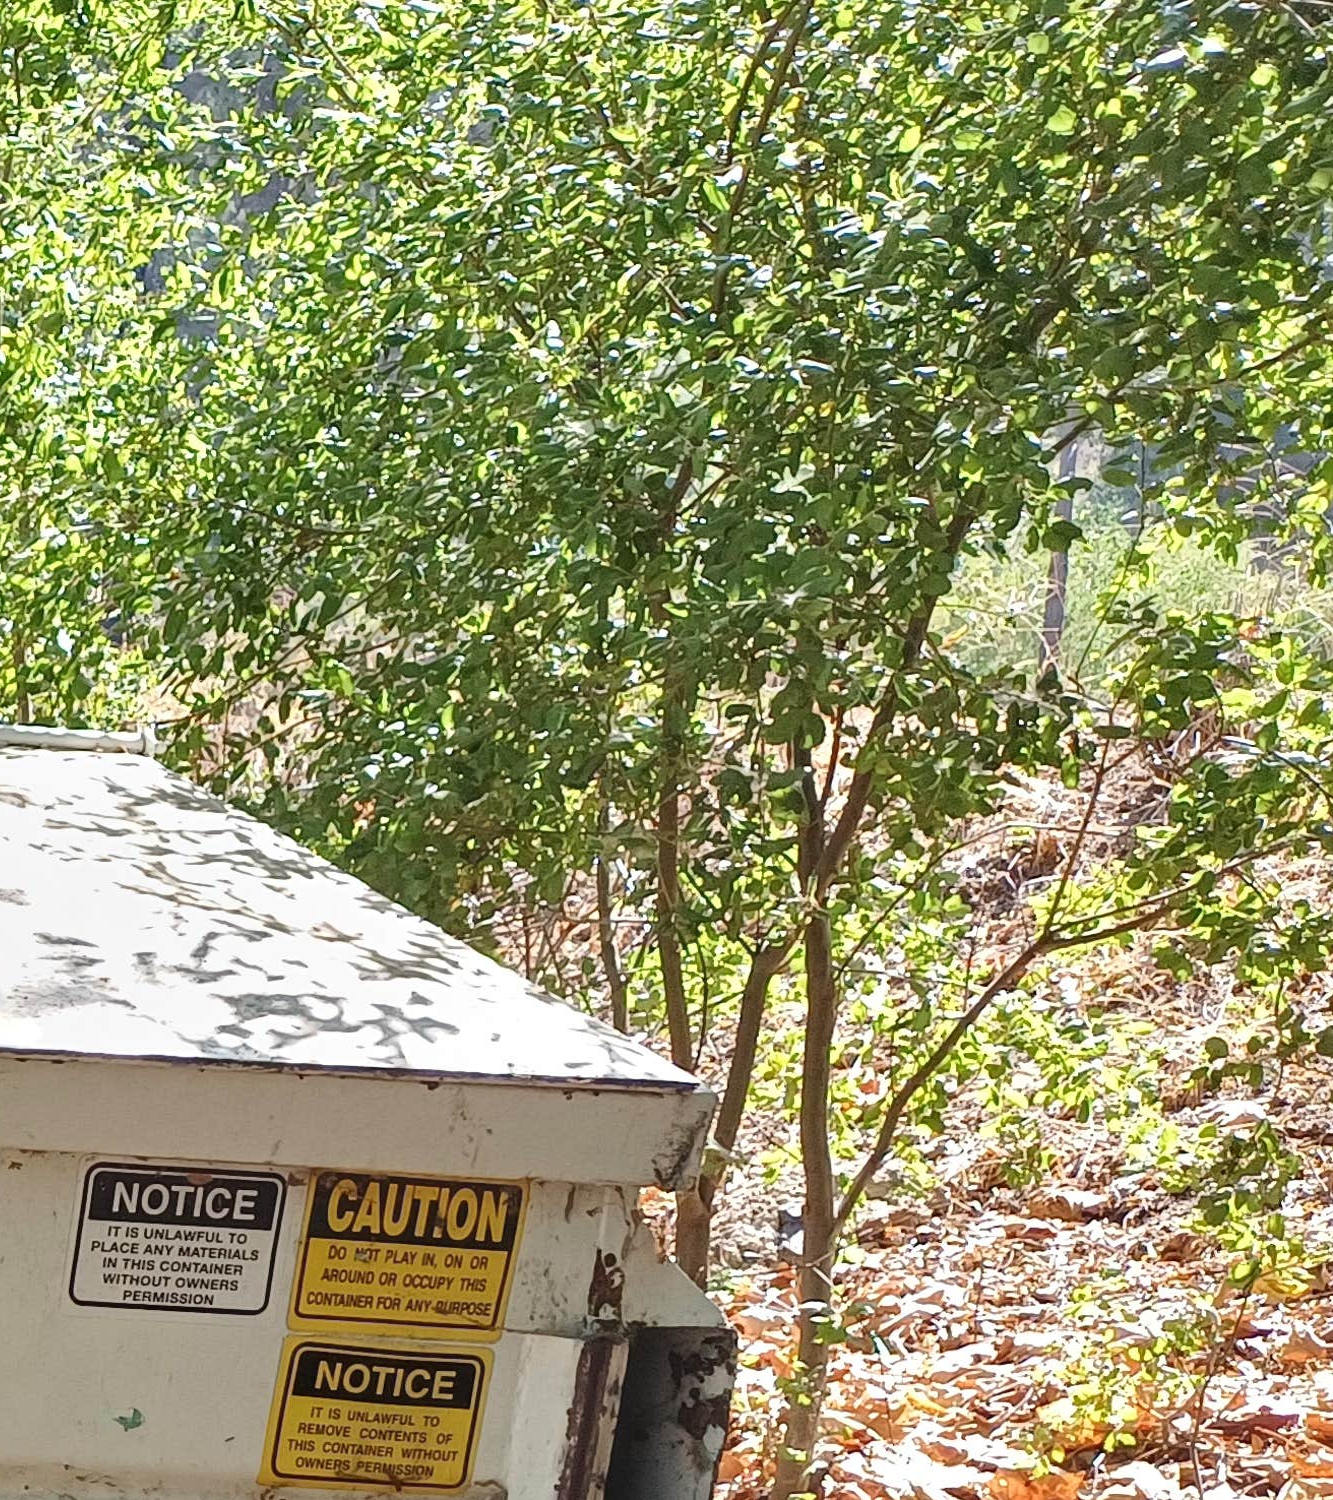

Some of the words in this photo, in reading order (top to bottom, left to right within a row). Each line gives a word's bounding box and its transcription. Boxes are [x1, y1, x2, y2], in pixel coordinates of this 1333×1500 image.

[112, 1181, 258, 1220] NOTICE
[327, 1178, 508, 1242] CAUTION
[107, 1226, 121, 1237] IT
[125, 1227, 139, 1238] IS
[144, 1228, 223, 1243] UNLAWFUL
[228, 1233, 247, 1243] TO
[91, 1241, 139, 1254] PLACE
[143, 1244, 173, 1255] ANY
[178, 1246, 259, 1260] MATERIALS
[328, 1245, 346, 1260] DO
[385, 1251, 417, 1264] PLAY
[422, 1253, 437, 1268] IN,
[445, 1254, 462, 1268] ON
[470, 1256, 488, 1269] OR
[103, 1257, 117, 1268] IN
[122, 1259, 155, 1270] THIS
[159, 1260, 243, 1275] CONTAINER
[103, 1274, 170, 1287] WITHOUT
[175, 1278, 238, 1291] OWNERS
[321, 1268, 374, 1284] AROUND
[379, 1272, 397, 1286] OR
[403, 1274, 454, 1290] OCCUPY
[460, 1278, 486, 1292] THIS
[123, 1291, 214, 1305] PERMISSION
[307, 1292, 373, 1308] CONTAINER
[376, 1295, 400, 1310] FOR
[405, 1299, 431, 1312] ANY
[435, 1301, 491, 1316] PURPOSE
[314, 1360, 456, 1400] NOTICE
[310, 1407, 323, 1417] IT
[329, 1408, 340, 1419] IS
[348, 1410, 415, 1426] UNLAWFUL
[423, 1416, 439, 1427] TO
[297, 1423, 350, 1437] REMOVE
[360, 1428, 427, 1443] CONTENTS
[437, 1433, 453, 1444] OF
[288, 1439, 315, 1451] THIS
[322, 1442, 393, 1457] CONTAINER
[401, 1448, 458, 1461] WITHOUT
[295, 1457, 350, 1470] OWNERS
[357, 1460, 434, 1476] PERMISSION
